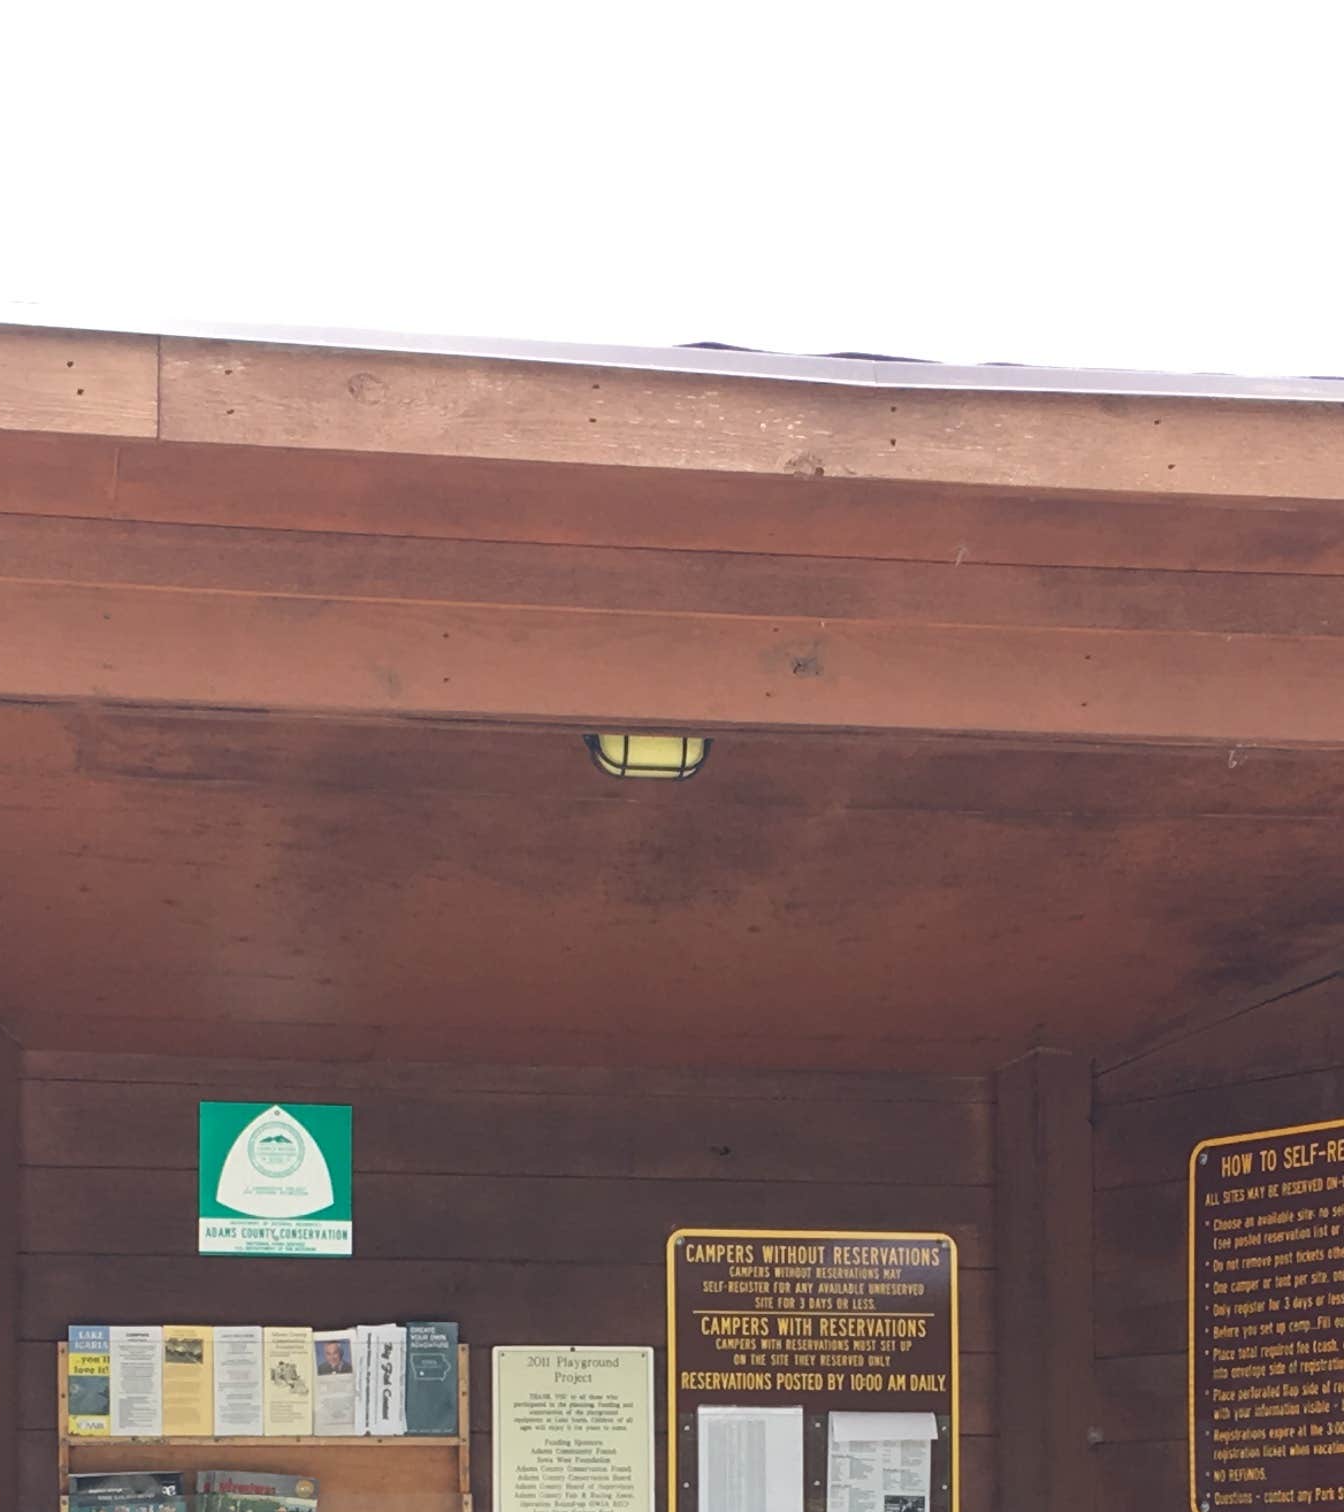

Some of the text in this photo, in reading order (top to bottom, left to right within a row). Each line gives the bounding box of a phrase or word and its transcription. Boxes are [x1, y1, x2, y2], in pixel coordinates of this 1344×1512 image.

[1221, 1153, 1252, 1177] HOW
[1260, 1150, 1276, 1172] TO
[1205, 1192, 1219, 1206] ALL
[206, 1228, 348, 1240] ADAMS COUNTY CONSERVATION
[686, 1245, 940, 1265] CAMPERS WITHOUT RESERVATIONS
[729, 1267, 901, 1279] CAMPERS WITHOUT RESERVATIONS MAY
[703, 1281, 924, 1295] SELF-REGISTER FOR ANY AVAILABLE UNRESERVED
[755, 1299, 773, 1309] SITE
[777, 1299, 795, 1309] FOR
[800, 1299, 805, 1309] 3
[808, 1299, 832, 1309] DAYS
[836, 1299, 848, 1309] OR
[701, 1318, 926, 1337] CAMPERS WITH RESERVATIONS
[715, 1339, 756, 1350] CAMPERS
[760, 1340, 782, 1350] WITH
[785, 1340, 849, 1351] RESERVATIONS
[880, 1340, 895, 1351] SET
[900, 1341, 912, 1351] UP
[528, 1357, 619, 1369] 2011 Playground
[750, 1355, 765, 1366] THE
[770, 1355, 788, 1366] SITE
[794, 1355, 815, 1366] THEY
[820, 1356, 864, 1366] RESERVED
[555, 1372, 592, 1384] Project
[681, 1373, 771, 1390] RESERVATIONS
[776, 1374, 823, 1390] POSTED
[827, 1374, 844, 1390] BY
[850, 1374, 882, 1391] 10:00
[887, 1374, 906, 1391] AM
